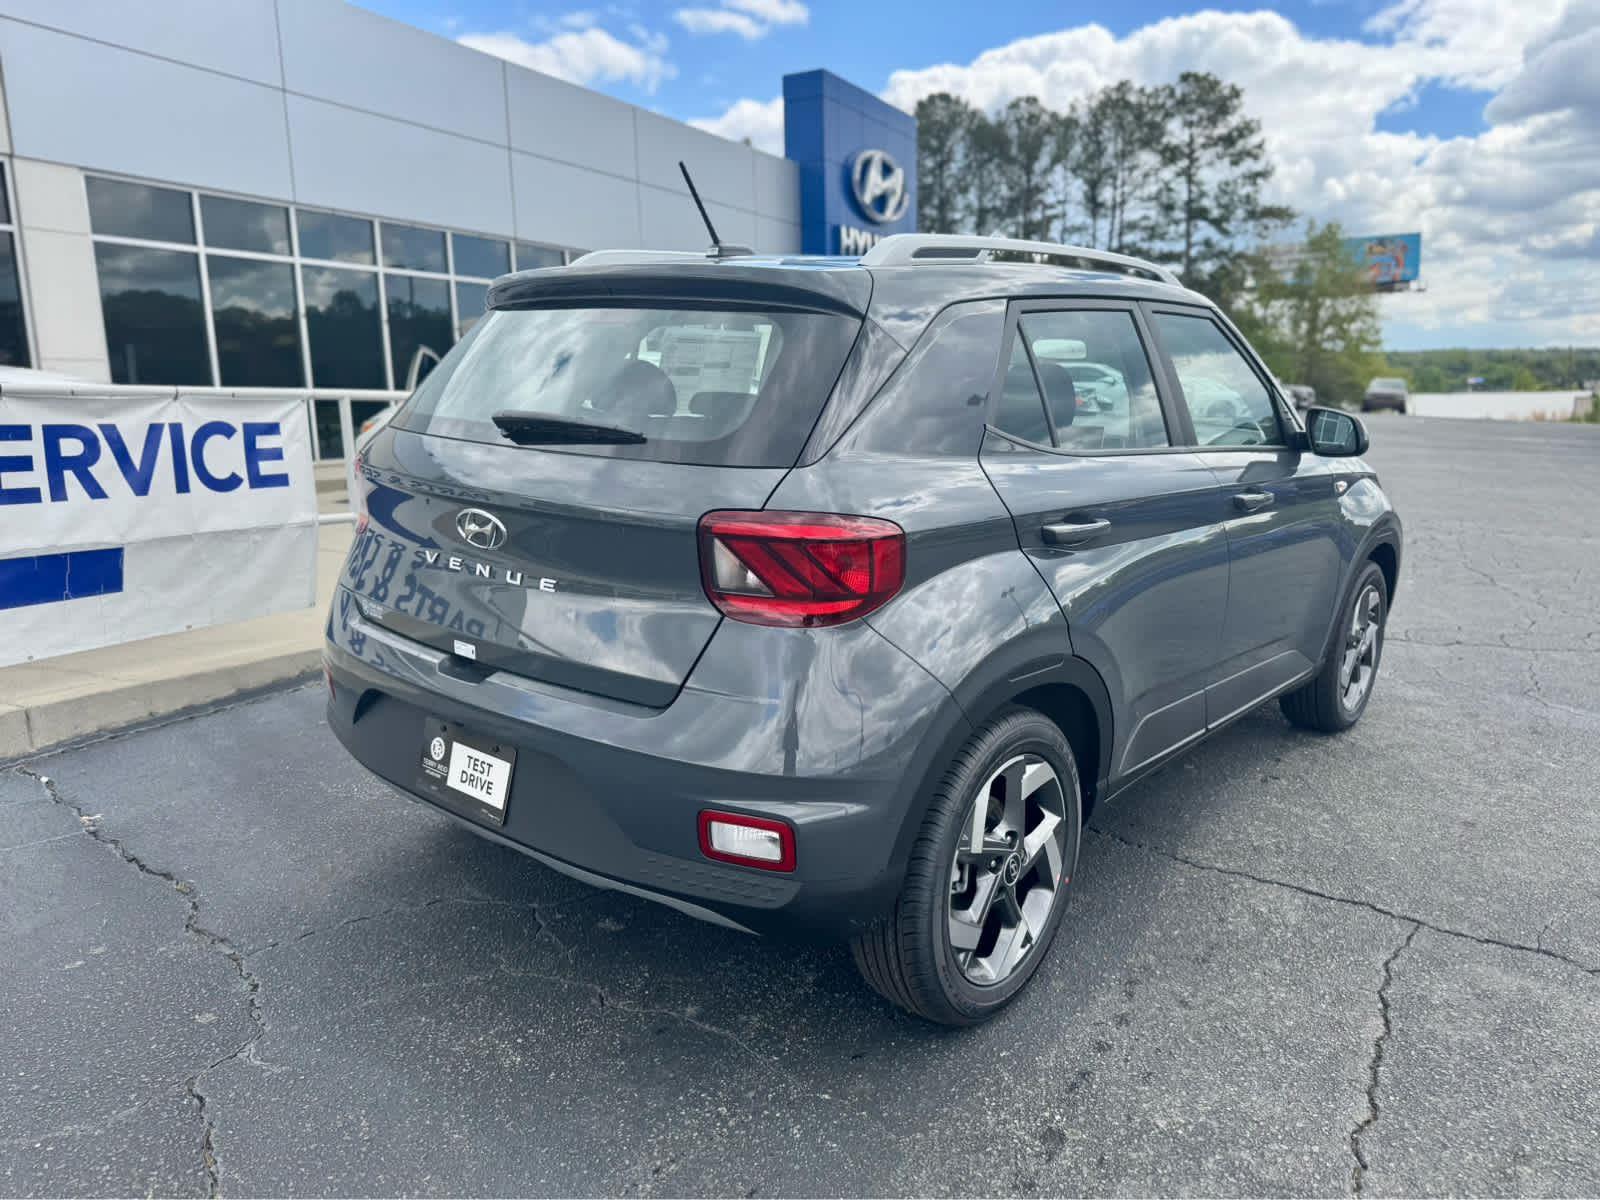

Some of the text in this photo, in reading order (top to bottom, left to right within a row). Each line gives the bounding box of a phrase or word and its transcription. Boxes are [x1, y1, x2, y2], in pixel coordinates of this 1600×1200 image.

[425, 550, 558, 593] VENUE
[467, 755, 494, 777] TEST
[460, 770, 494, 796] DRIVE
